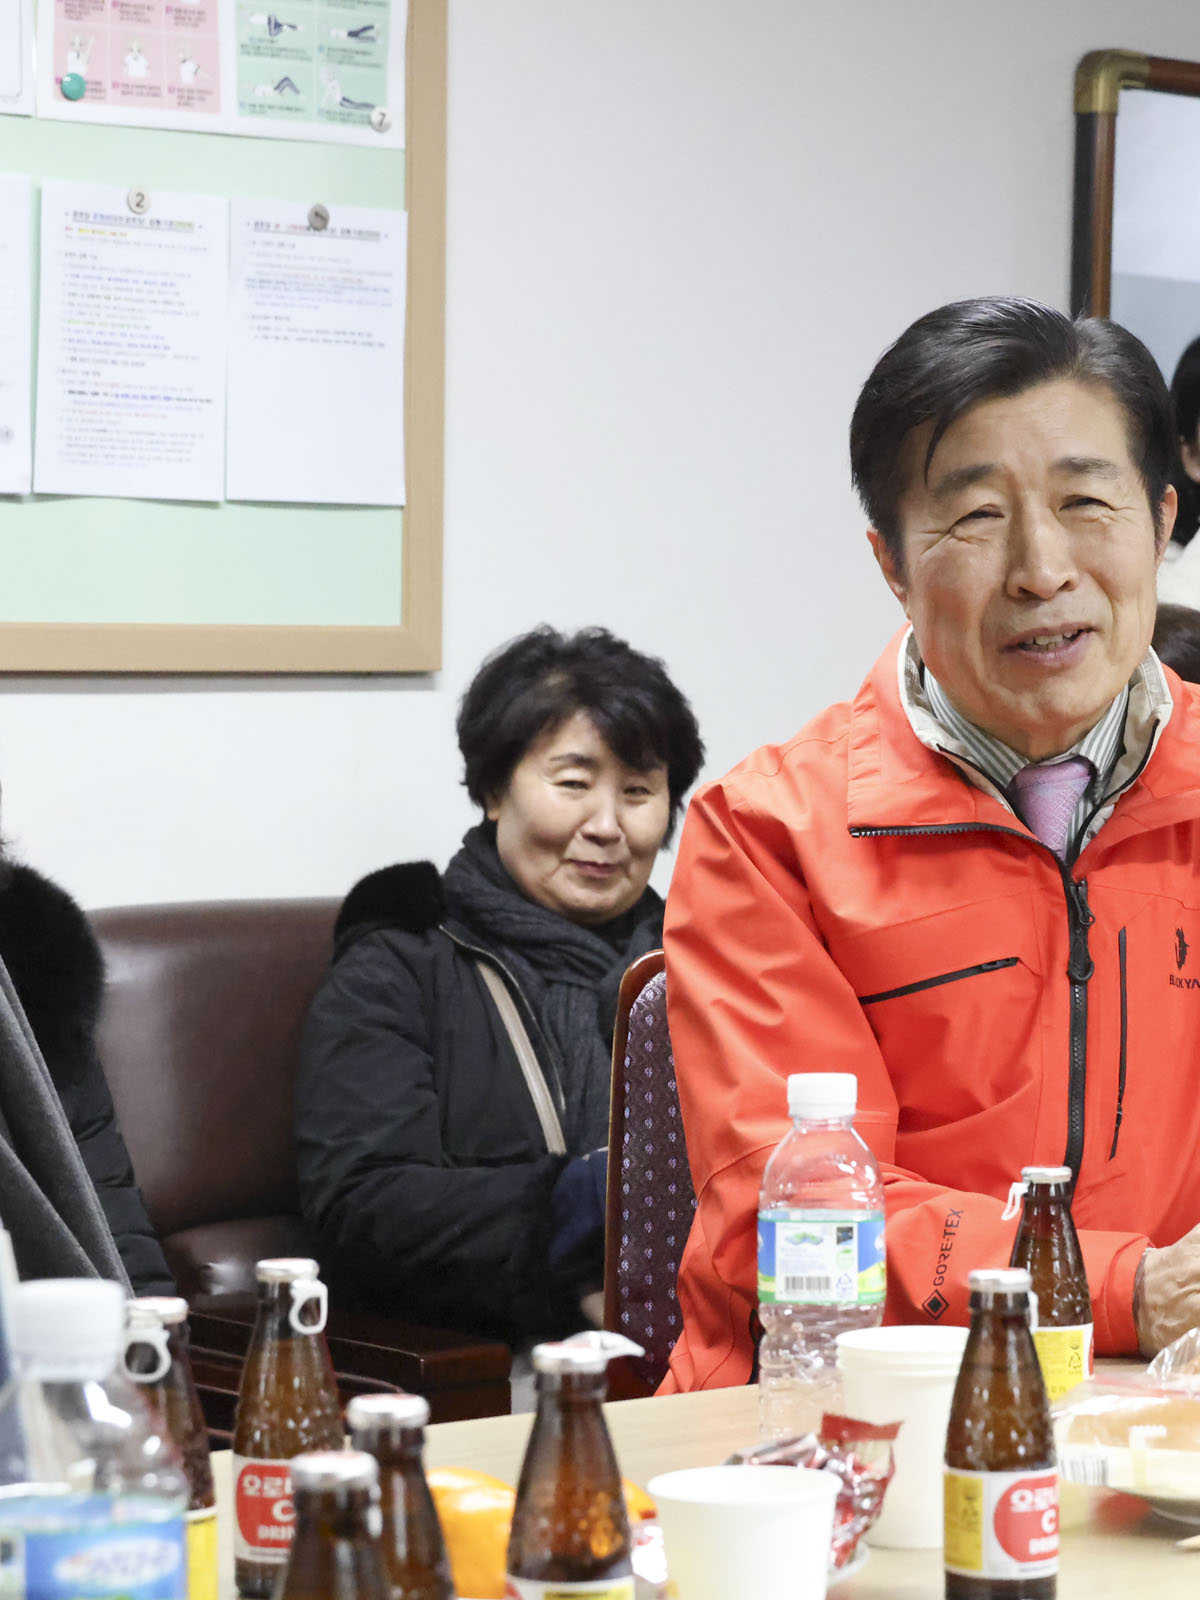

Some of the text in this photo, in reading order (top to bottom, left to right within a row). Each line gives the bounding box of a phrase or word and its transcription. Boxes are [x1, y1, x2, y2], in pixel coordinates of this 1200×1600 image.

[135, 192, 145, 209] 2
[933, 1207, 964, 1287] GORE-TEX
[272, 1499, 296, 1523] C
